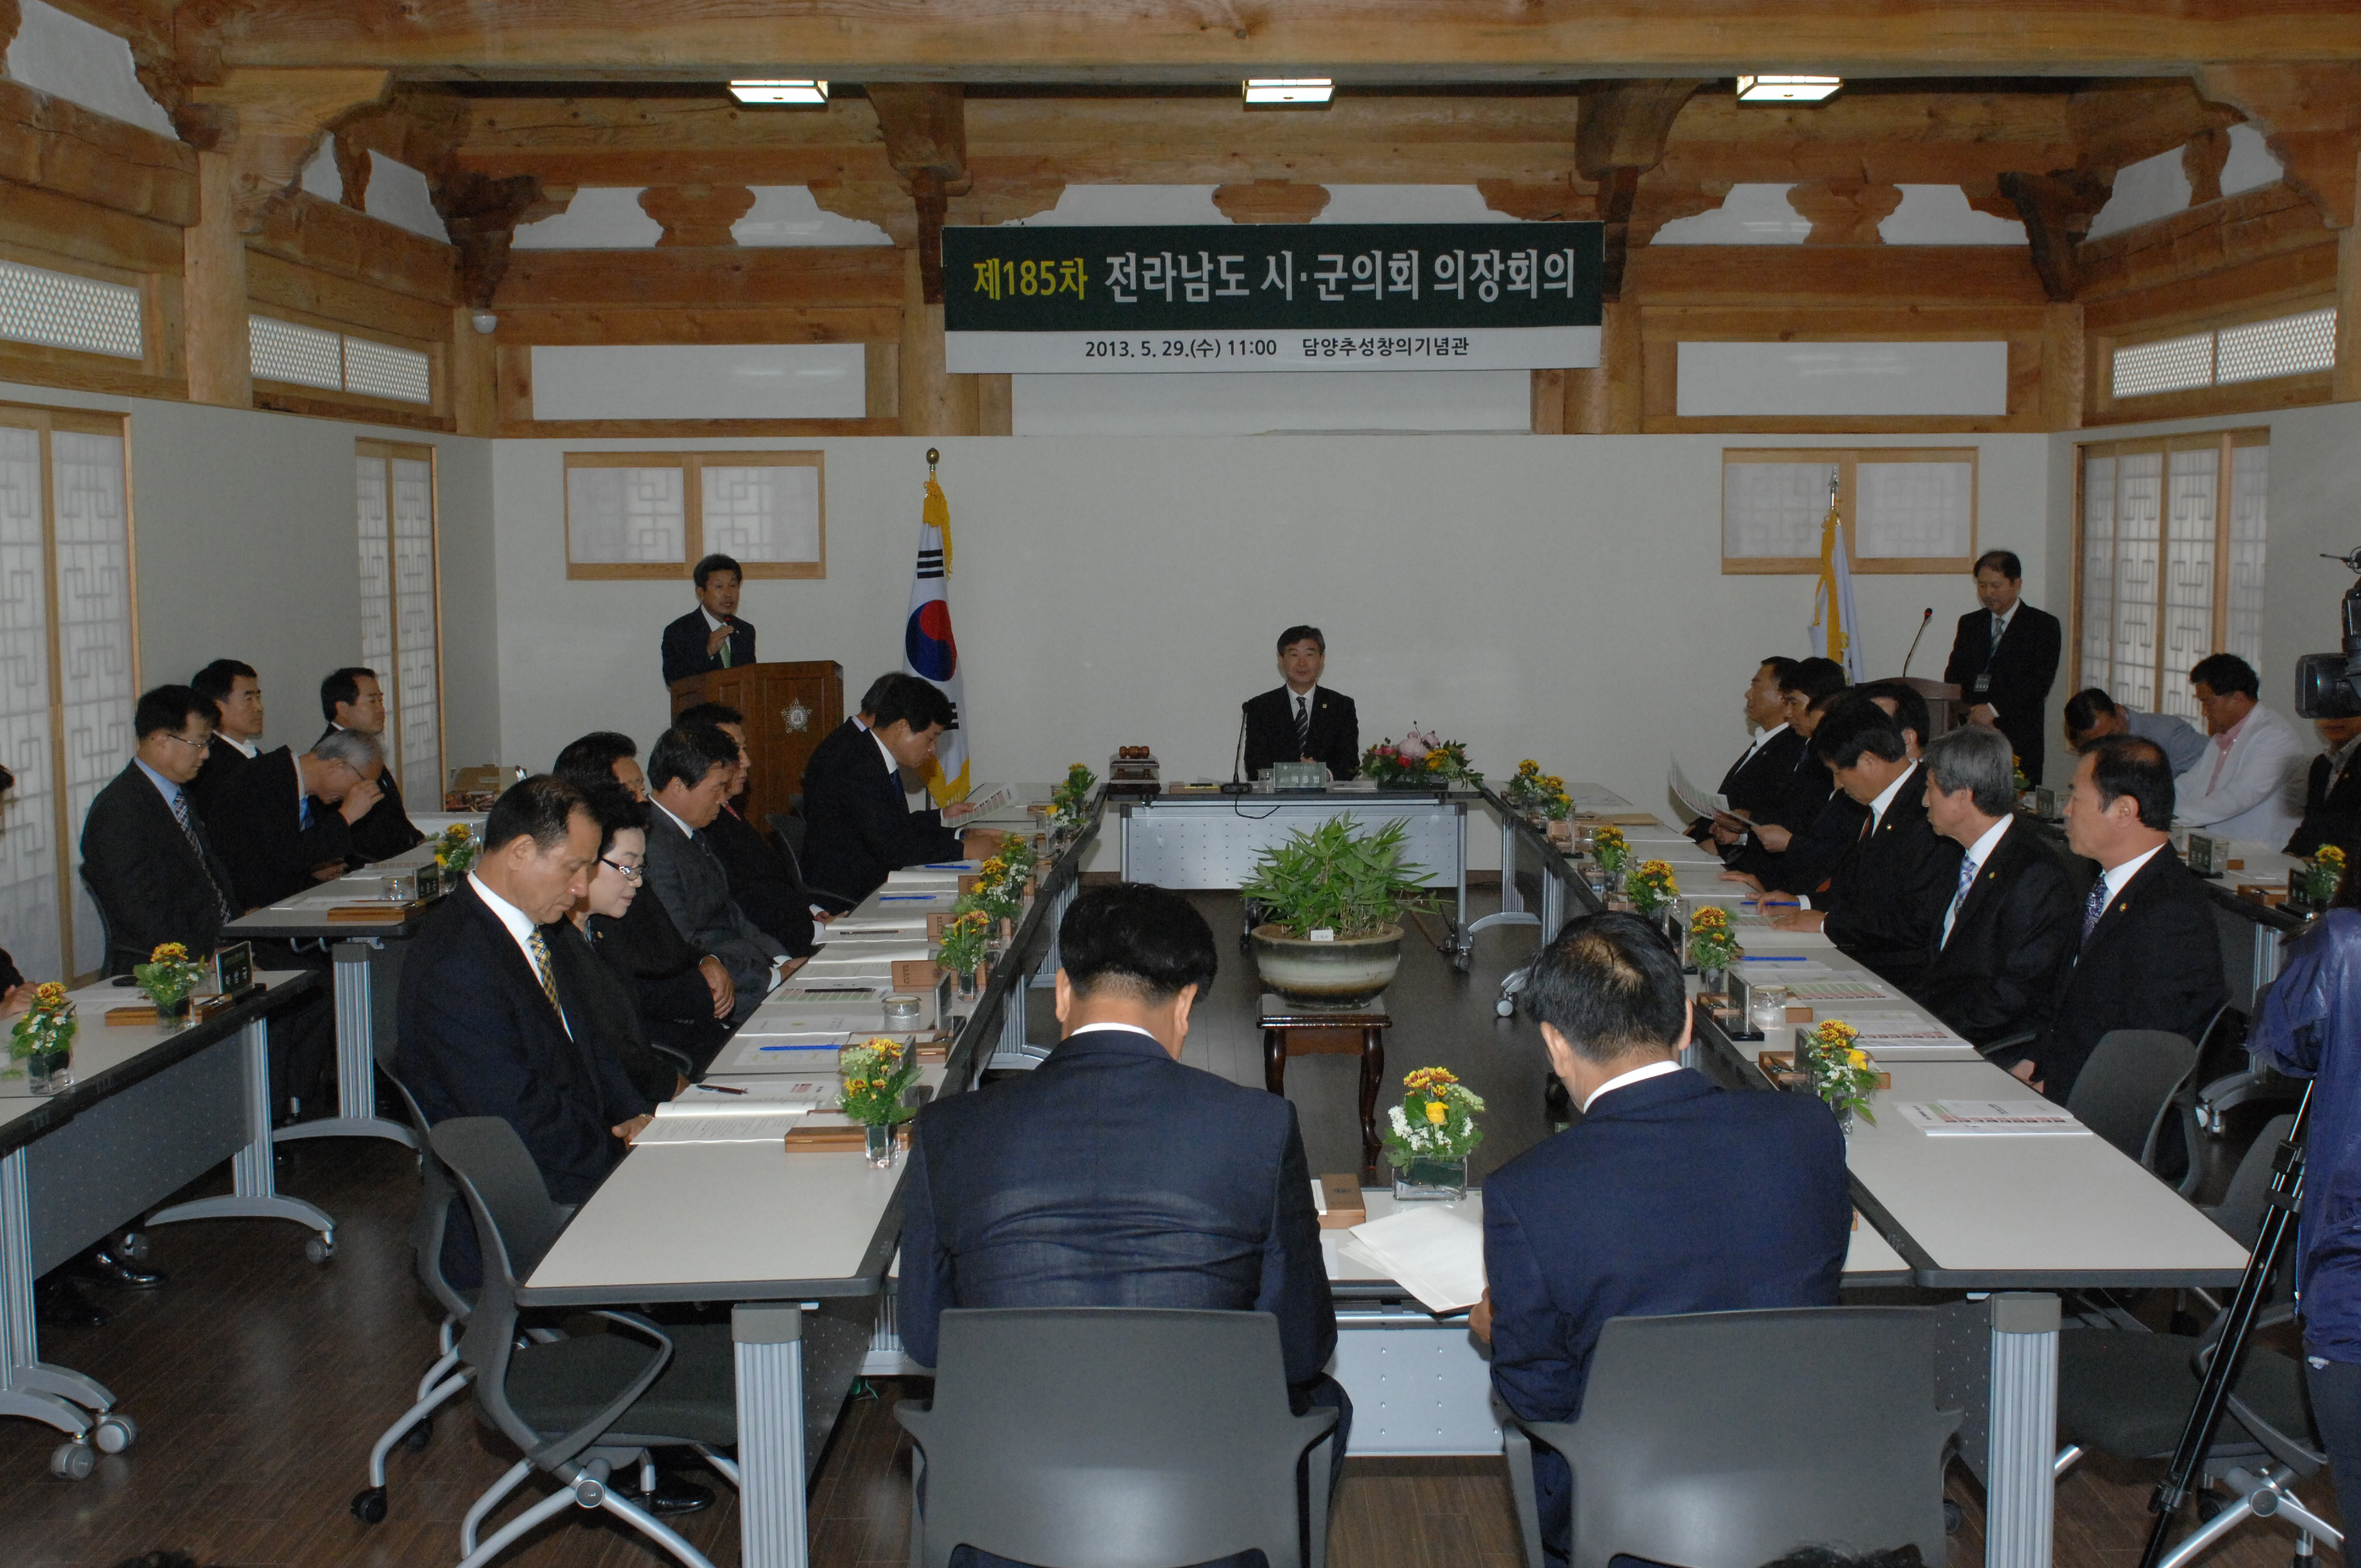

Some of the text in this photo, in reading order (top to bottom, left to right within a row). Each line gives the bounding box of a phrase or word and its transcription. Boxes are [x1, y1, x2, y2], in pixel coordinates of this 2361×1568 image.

[973, 249, 1574, 302] 제185차 전라남도 시·군의회 의장회의
[1085, 337, 1470, 358] 2013. 5. 29.(수) 11:00 담양추성창의기념관
